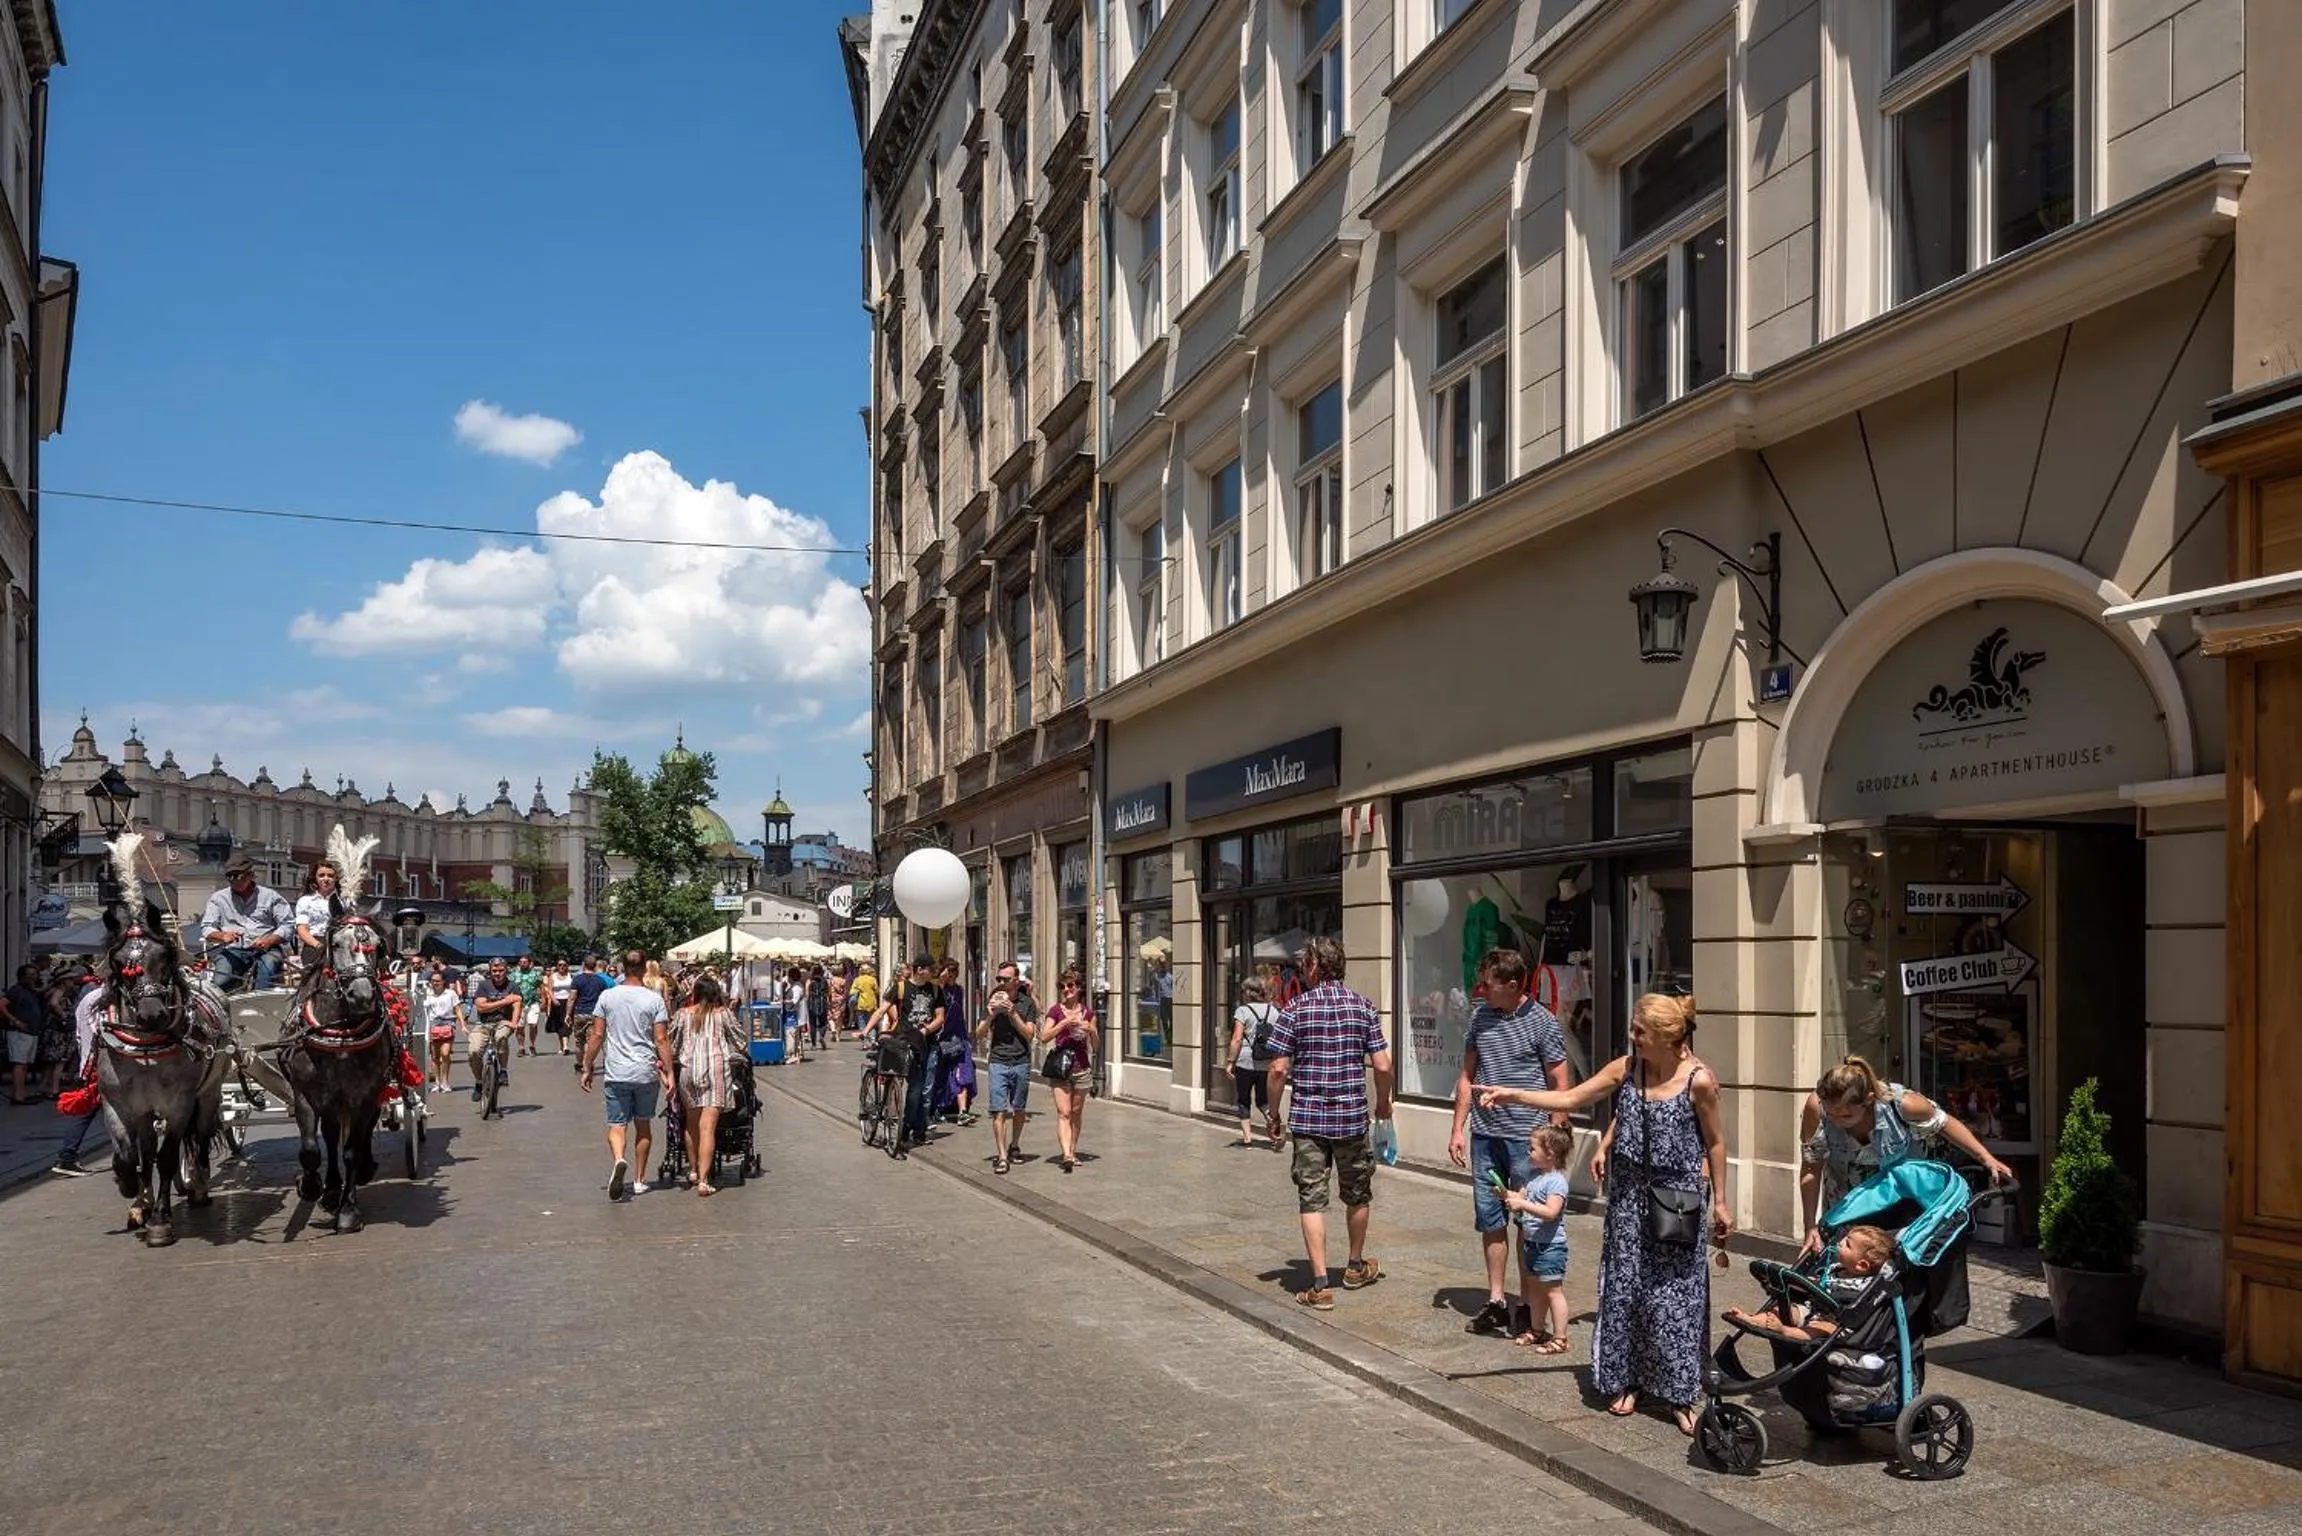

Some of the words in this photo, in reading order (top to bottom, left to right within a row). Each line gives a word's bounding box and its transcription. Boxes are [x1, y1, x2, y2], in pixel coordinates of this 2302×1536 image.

[1769, 671, 1779, 689] 4
[1243, 754, 1306, 797] MaxMara
[1856, 772, 1920, 795] GRODZKA
[1930, 769, 1938, 783] 4
[1114, 799, 1156, 832] MaxMara
[1907, 889, 1942, 908] Beer
[1945, 892, 1956, 908] &
[1959, 890, 2004, 909] panini
[1904, 965, 1958, 989] Coffee
[1961, 958, 1998, 981] Club
